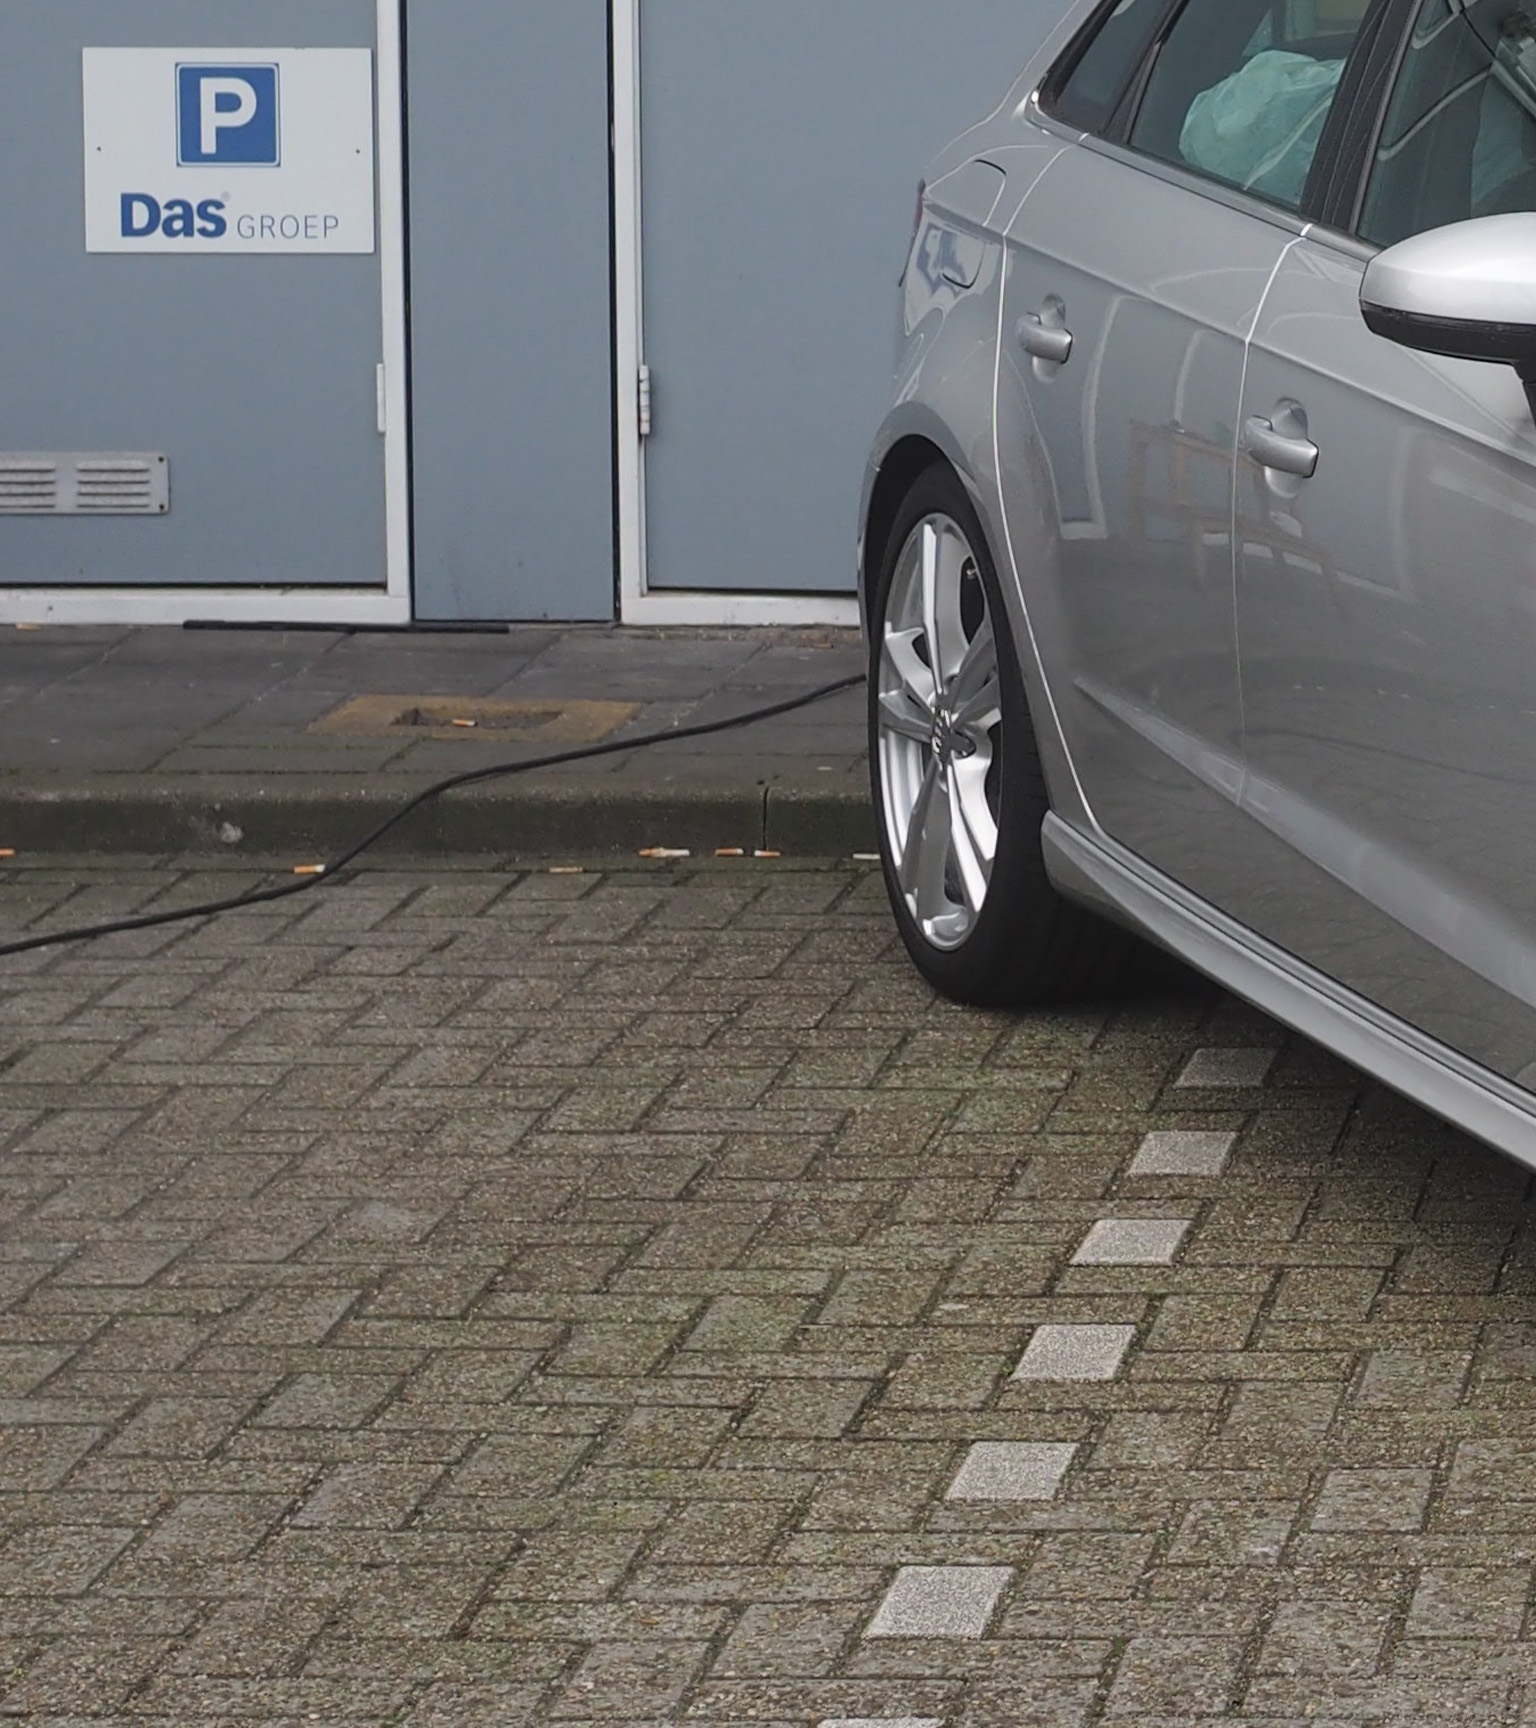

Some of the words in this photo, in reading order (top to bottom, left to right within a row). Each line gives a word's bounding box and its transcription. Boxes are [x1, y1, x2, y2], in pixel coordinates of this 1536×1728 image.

[200, 77, 257, 154] P
[120, 192, 227, 238] Das
[237, 215, 339, 239] GROEP
